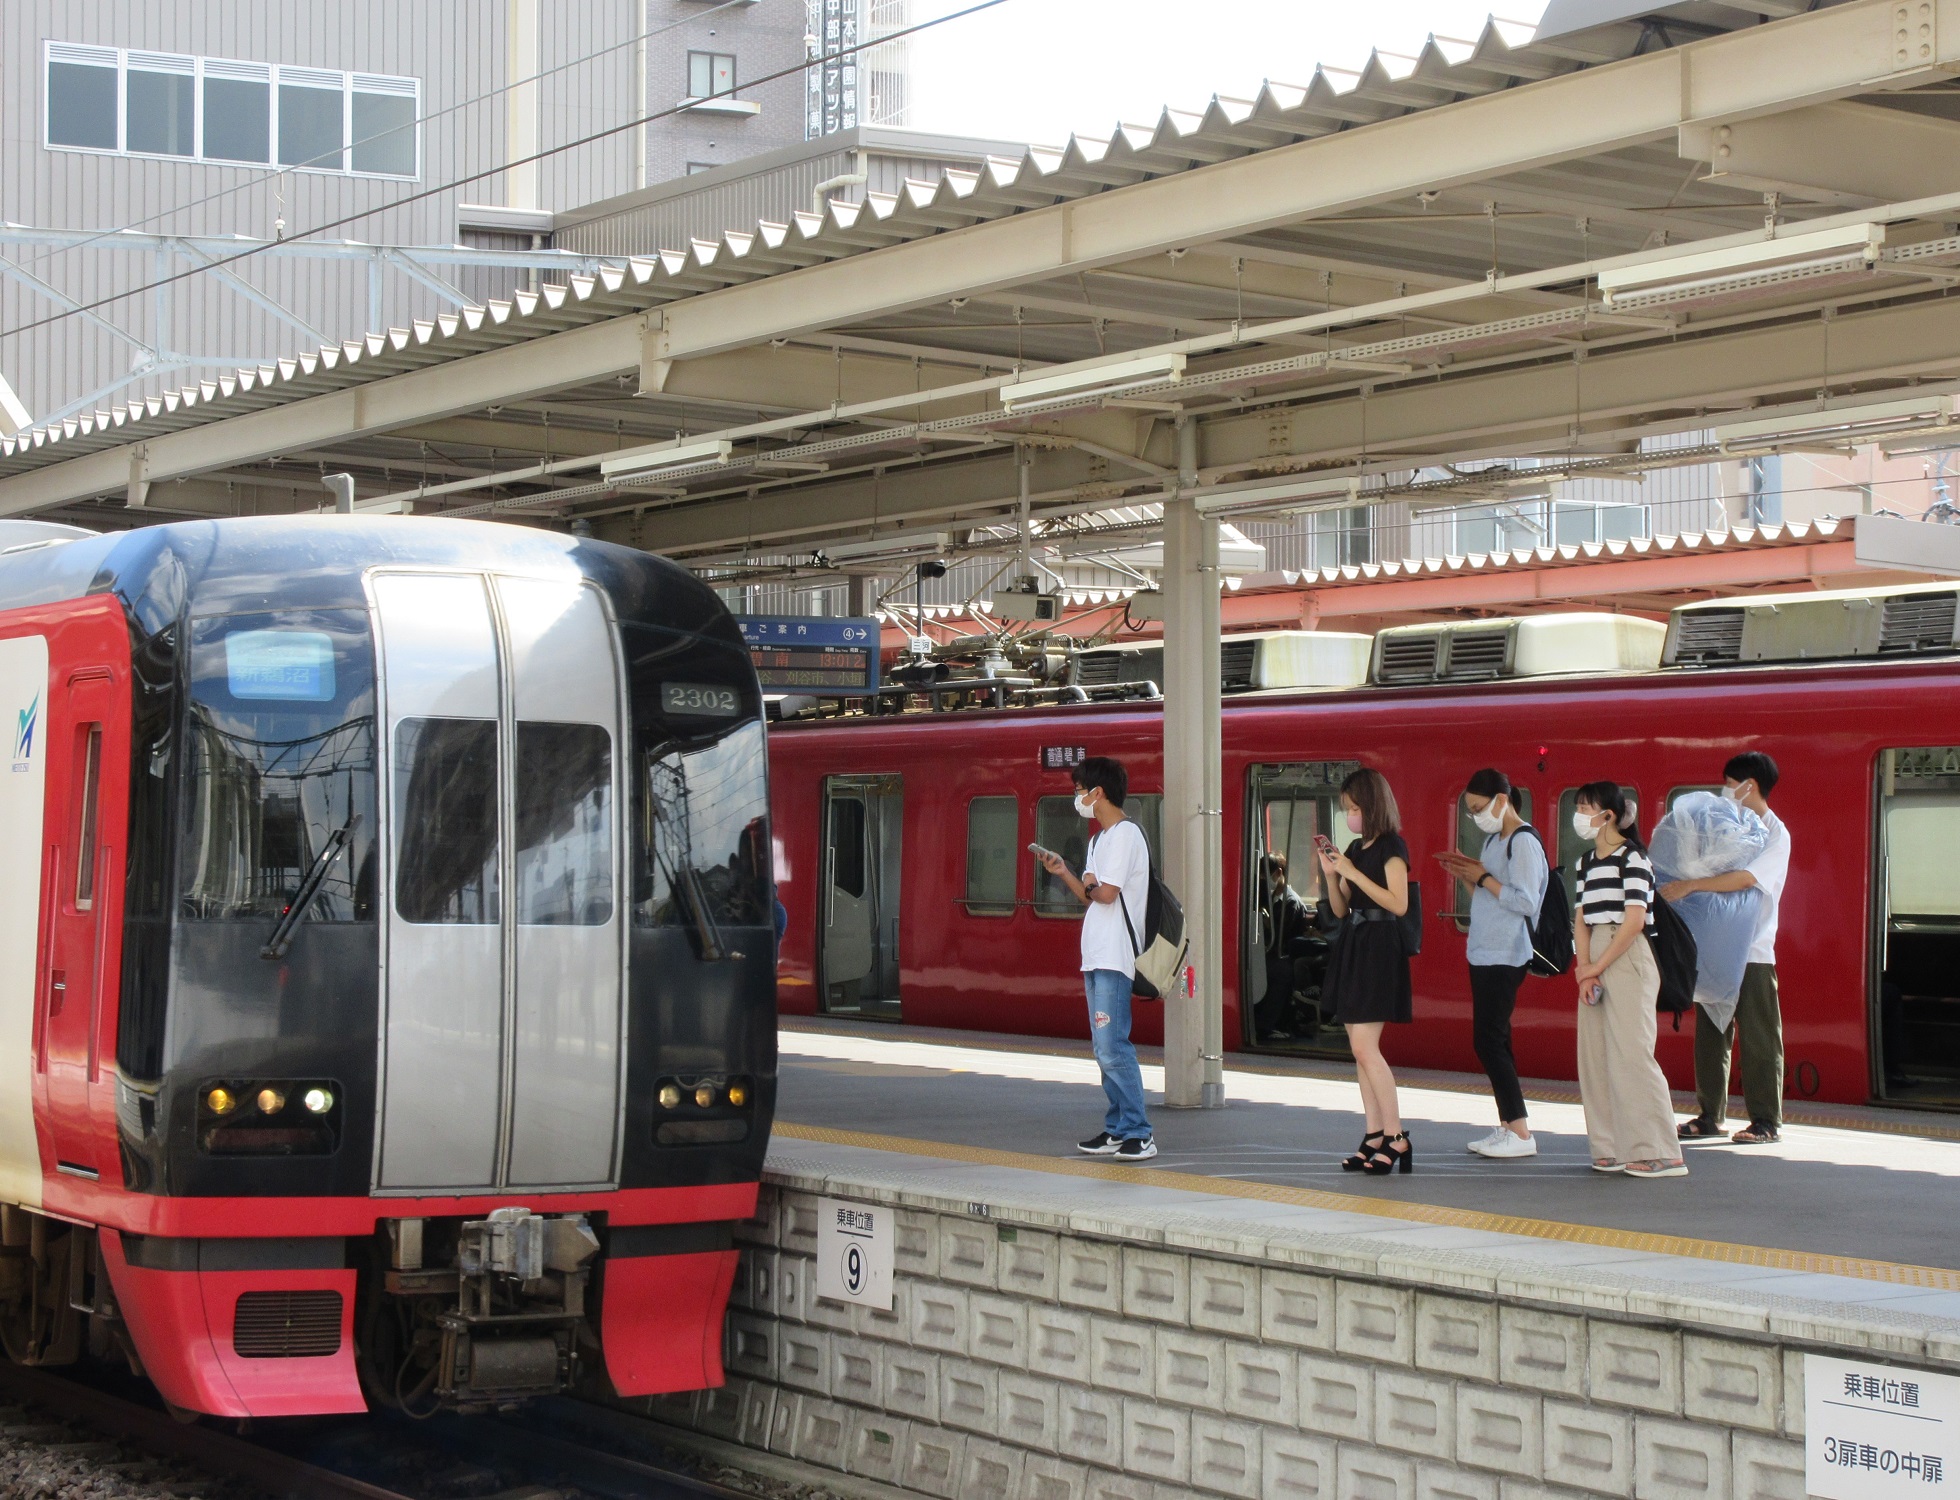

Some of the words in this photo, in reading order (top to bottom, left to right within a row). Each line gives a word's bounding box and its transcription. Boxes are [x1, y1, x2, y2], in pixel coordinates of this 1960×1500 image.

[669, 687, 736, 710] 2302
[837, 1208, 874, 1232] 乗車位置
[848, 1248, 861, 1290] 9
[1844, 1373, 1920, 1408] 乗車位置
[1824, 1436, 1943, 1484] 3扉車の中扉
